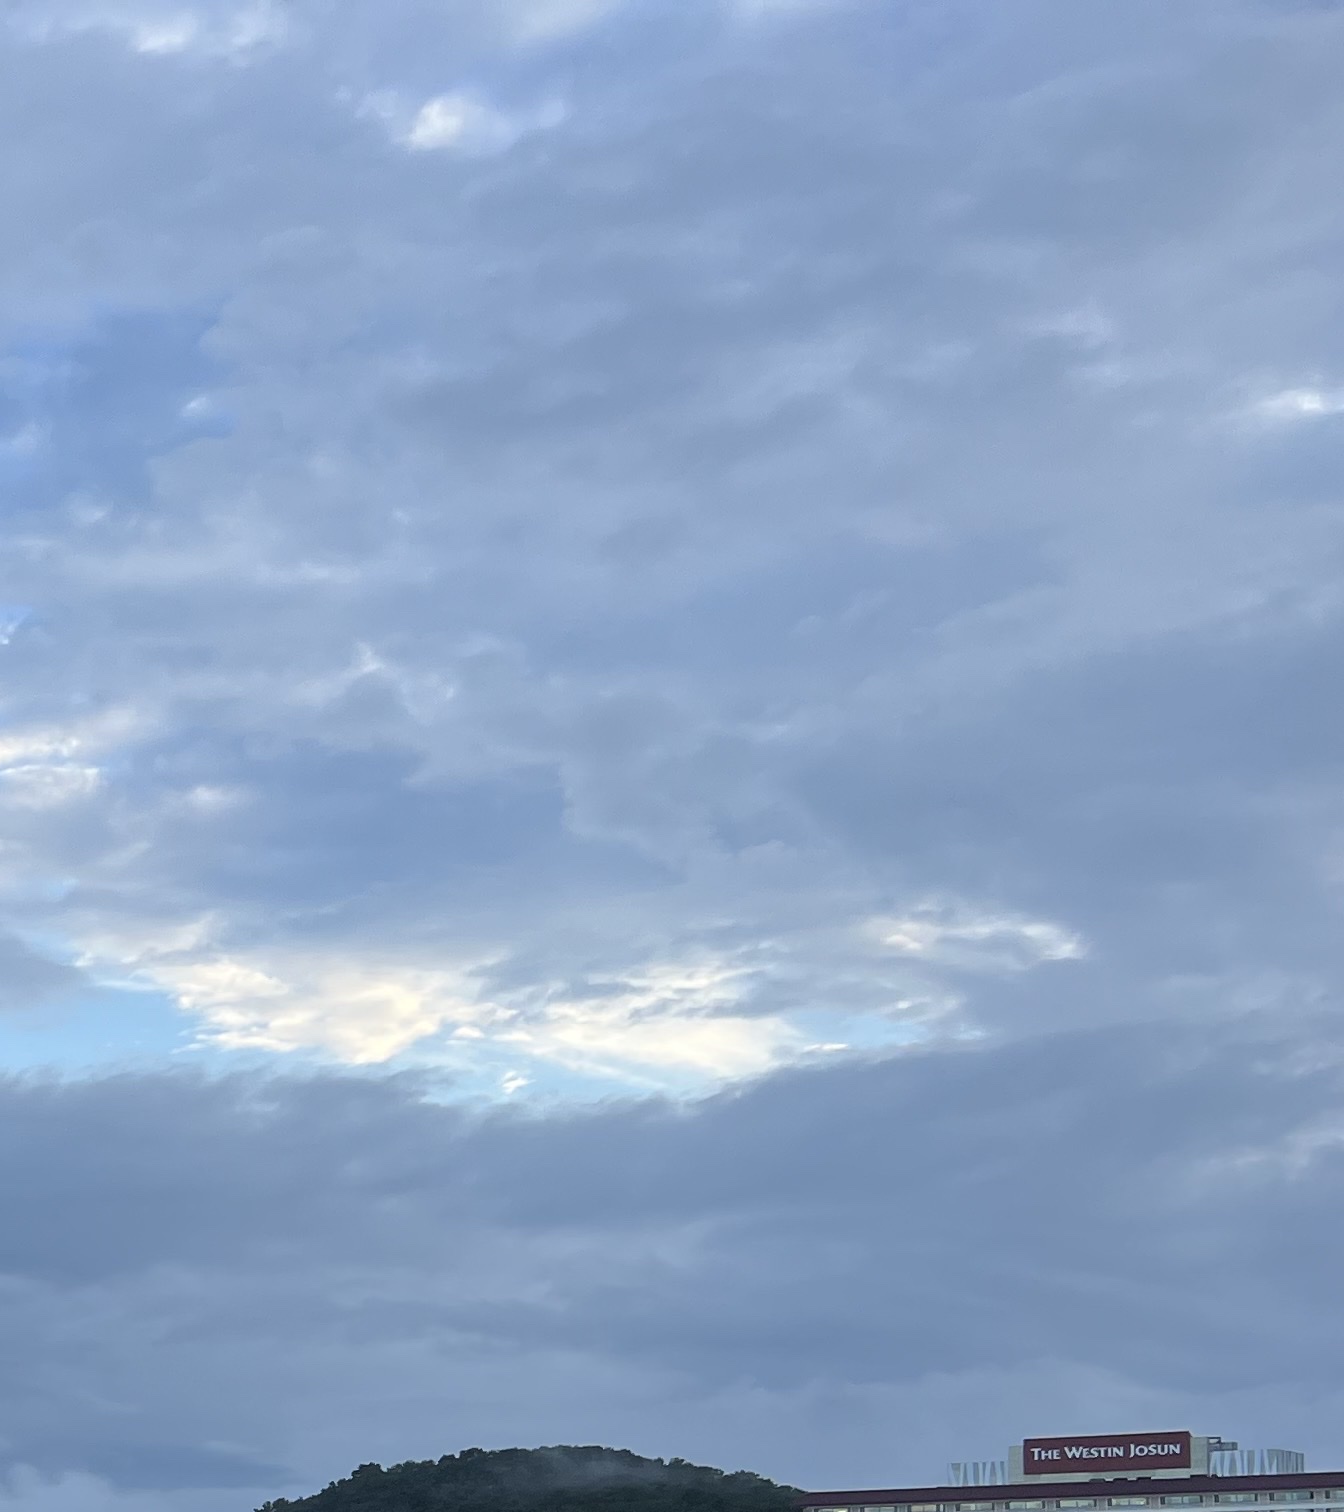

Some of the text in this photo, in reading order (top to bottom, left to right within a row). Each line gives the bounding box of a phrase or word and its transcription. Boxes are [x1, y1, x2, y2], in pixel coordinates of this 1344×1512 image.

[1031, 1443, 1181, 1460] THE WESTIN JOSUN
